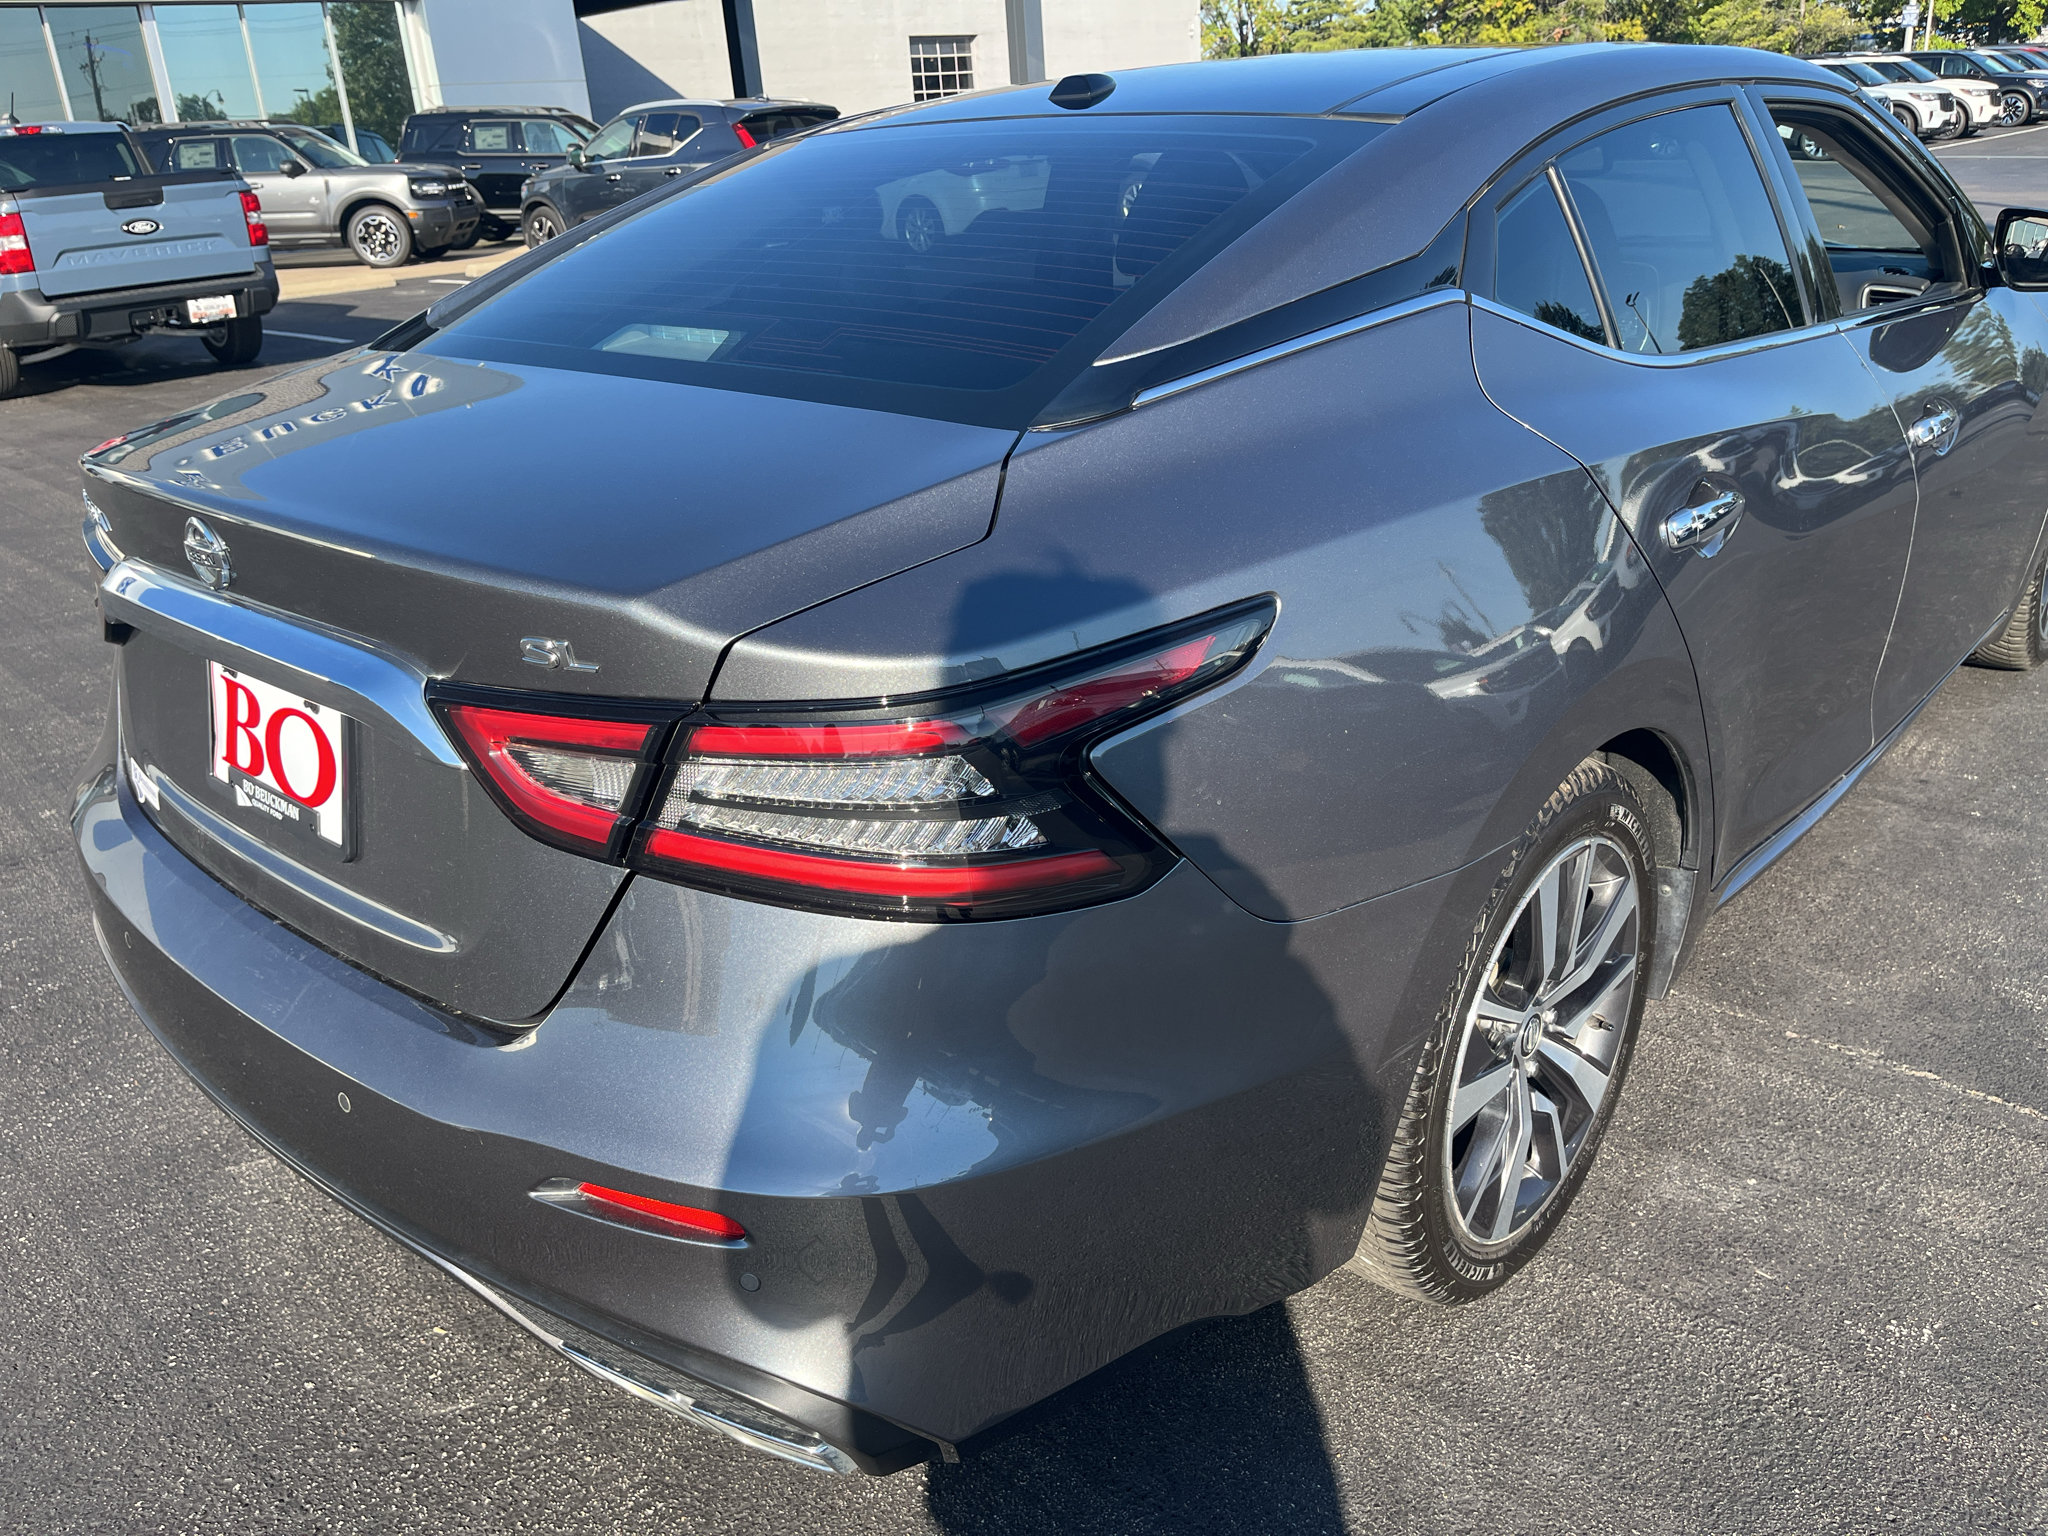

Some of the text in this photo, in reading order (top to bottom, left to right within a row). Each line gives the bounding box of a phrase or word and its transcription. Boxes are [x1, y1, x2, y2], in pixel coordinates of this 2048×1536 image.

[520, 636, 600, 673] SL
[220, 674, 337, 808] BO
[242, 779, 300, 821] BO BEUCKMAN
[1444, 1242, 1491, 1280] MICHELIN
